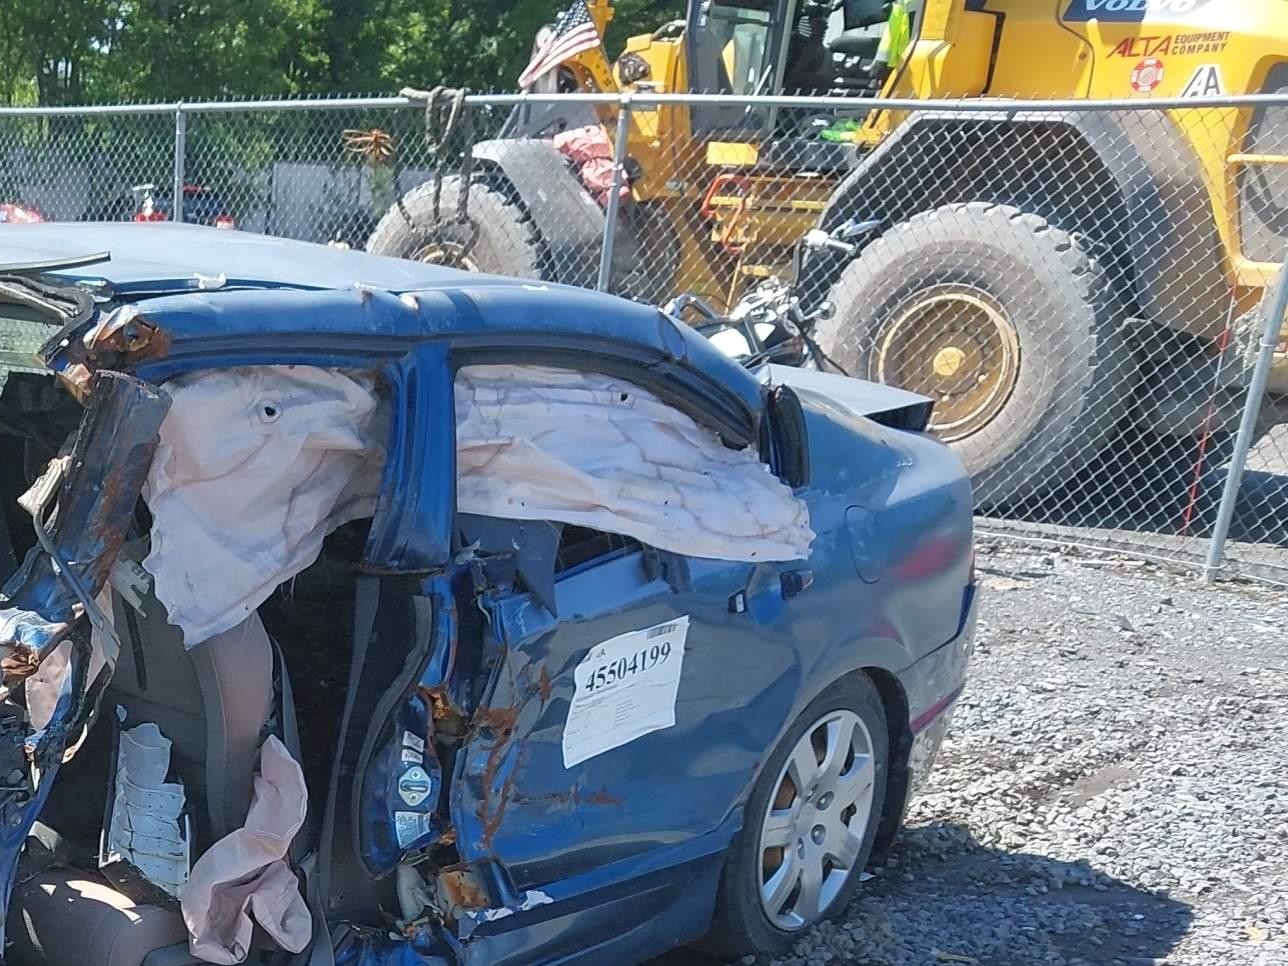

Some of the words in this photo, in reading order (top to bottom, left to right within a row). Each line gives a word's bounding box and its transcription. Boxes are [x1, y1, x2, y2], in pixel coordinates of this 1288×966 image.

[1086, 0, 1198, 12] VOLVO
[1106, 35, 1172, 59] ALTA
[1174, 31, 1231, 45] EQUIPMENT
[1171, 42, 1227, 56] COMPANY
[585, 642, 672, 692] 45504199
